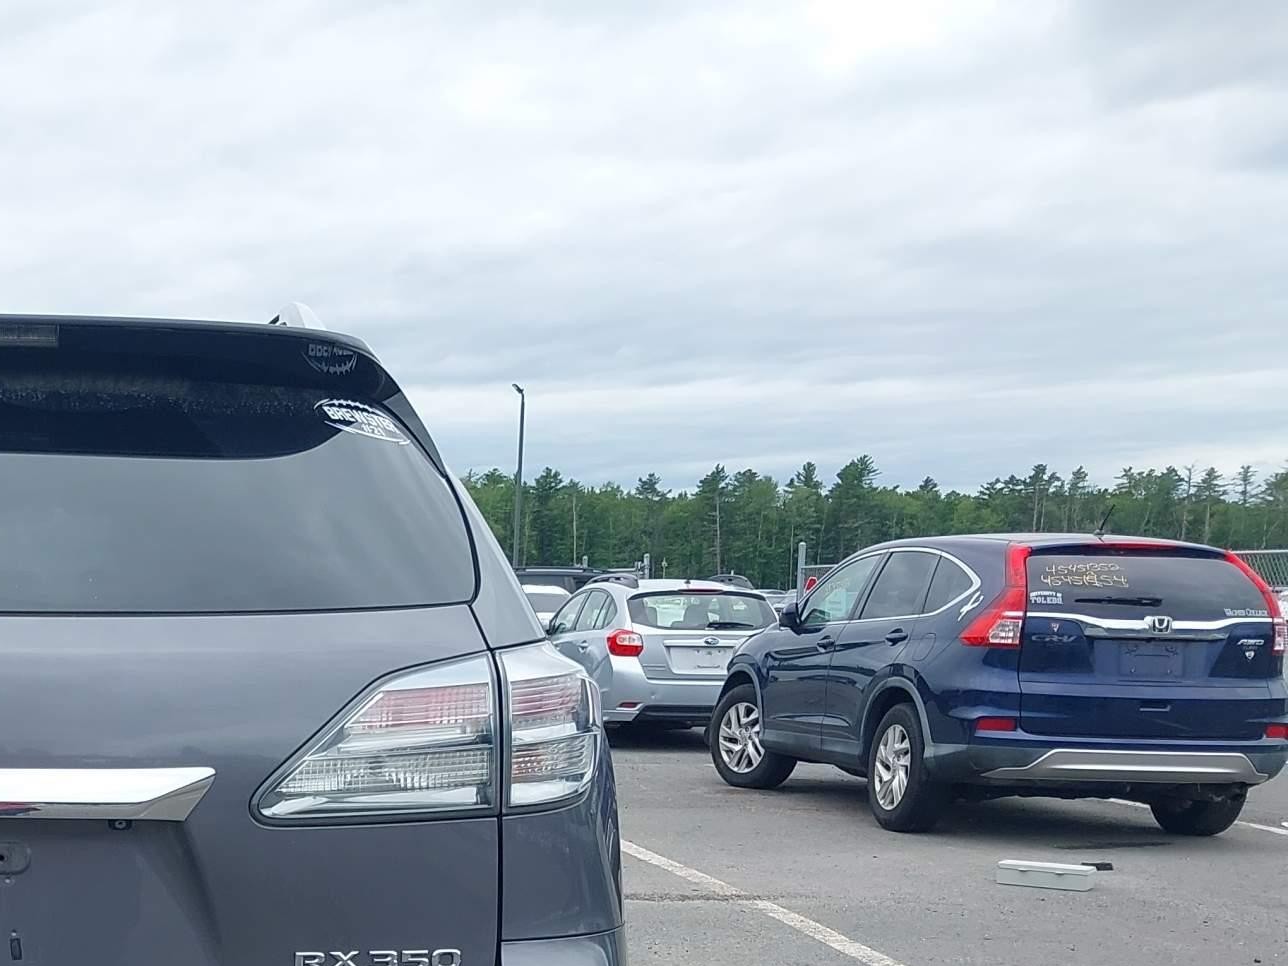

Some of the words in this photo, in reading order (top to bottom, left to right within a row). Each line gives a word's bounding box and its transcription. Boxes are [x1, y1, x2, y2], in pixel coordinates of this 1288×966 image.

[321, 404, 400, 434] BREWSTER
[1030, 596, 1063, 604] TOLEDO
[1236, 638, 1265, 646] AWD
